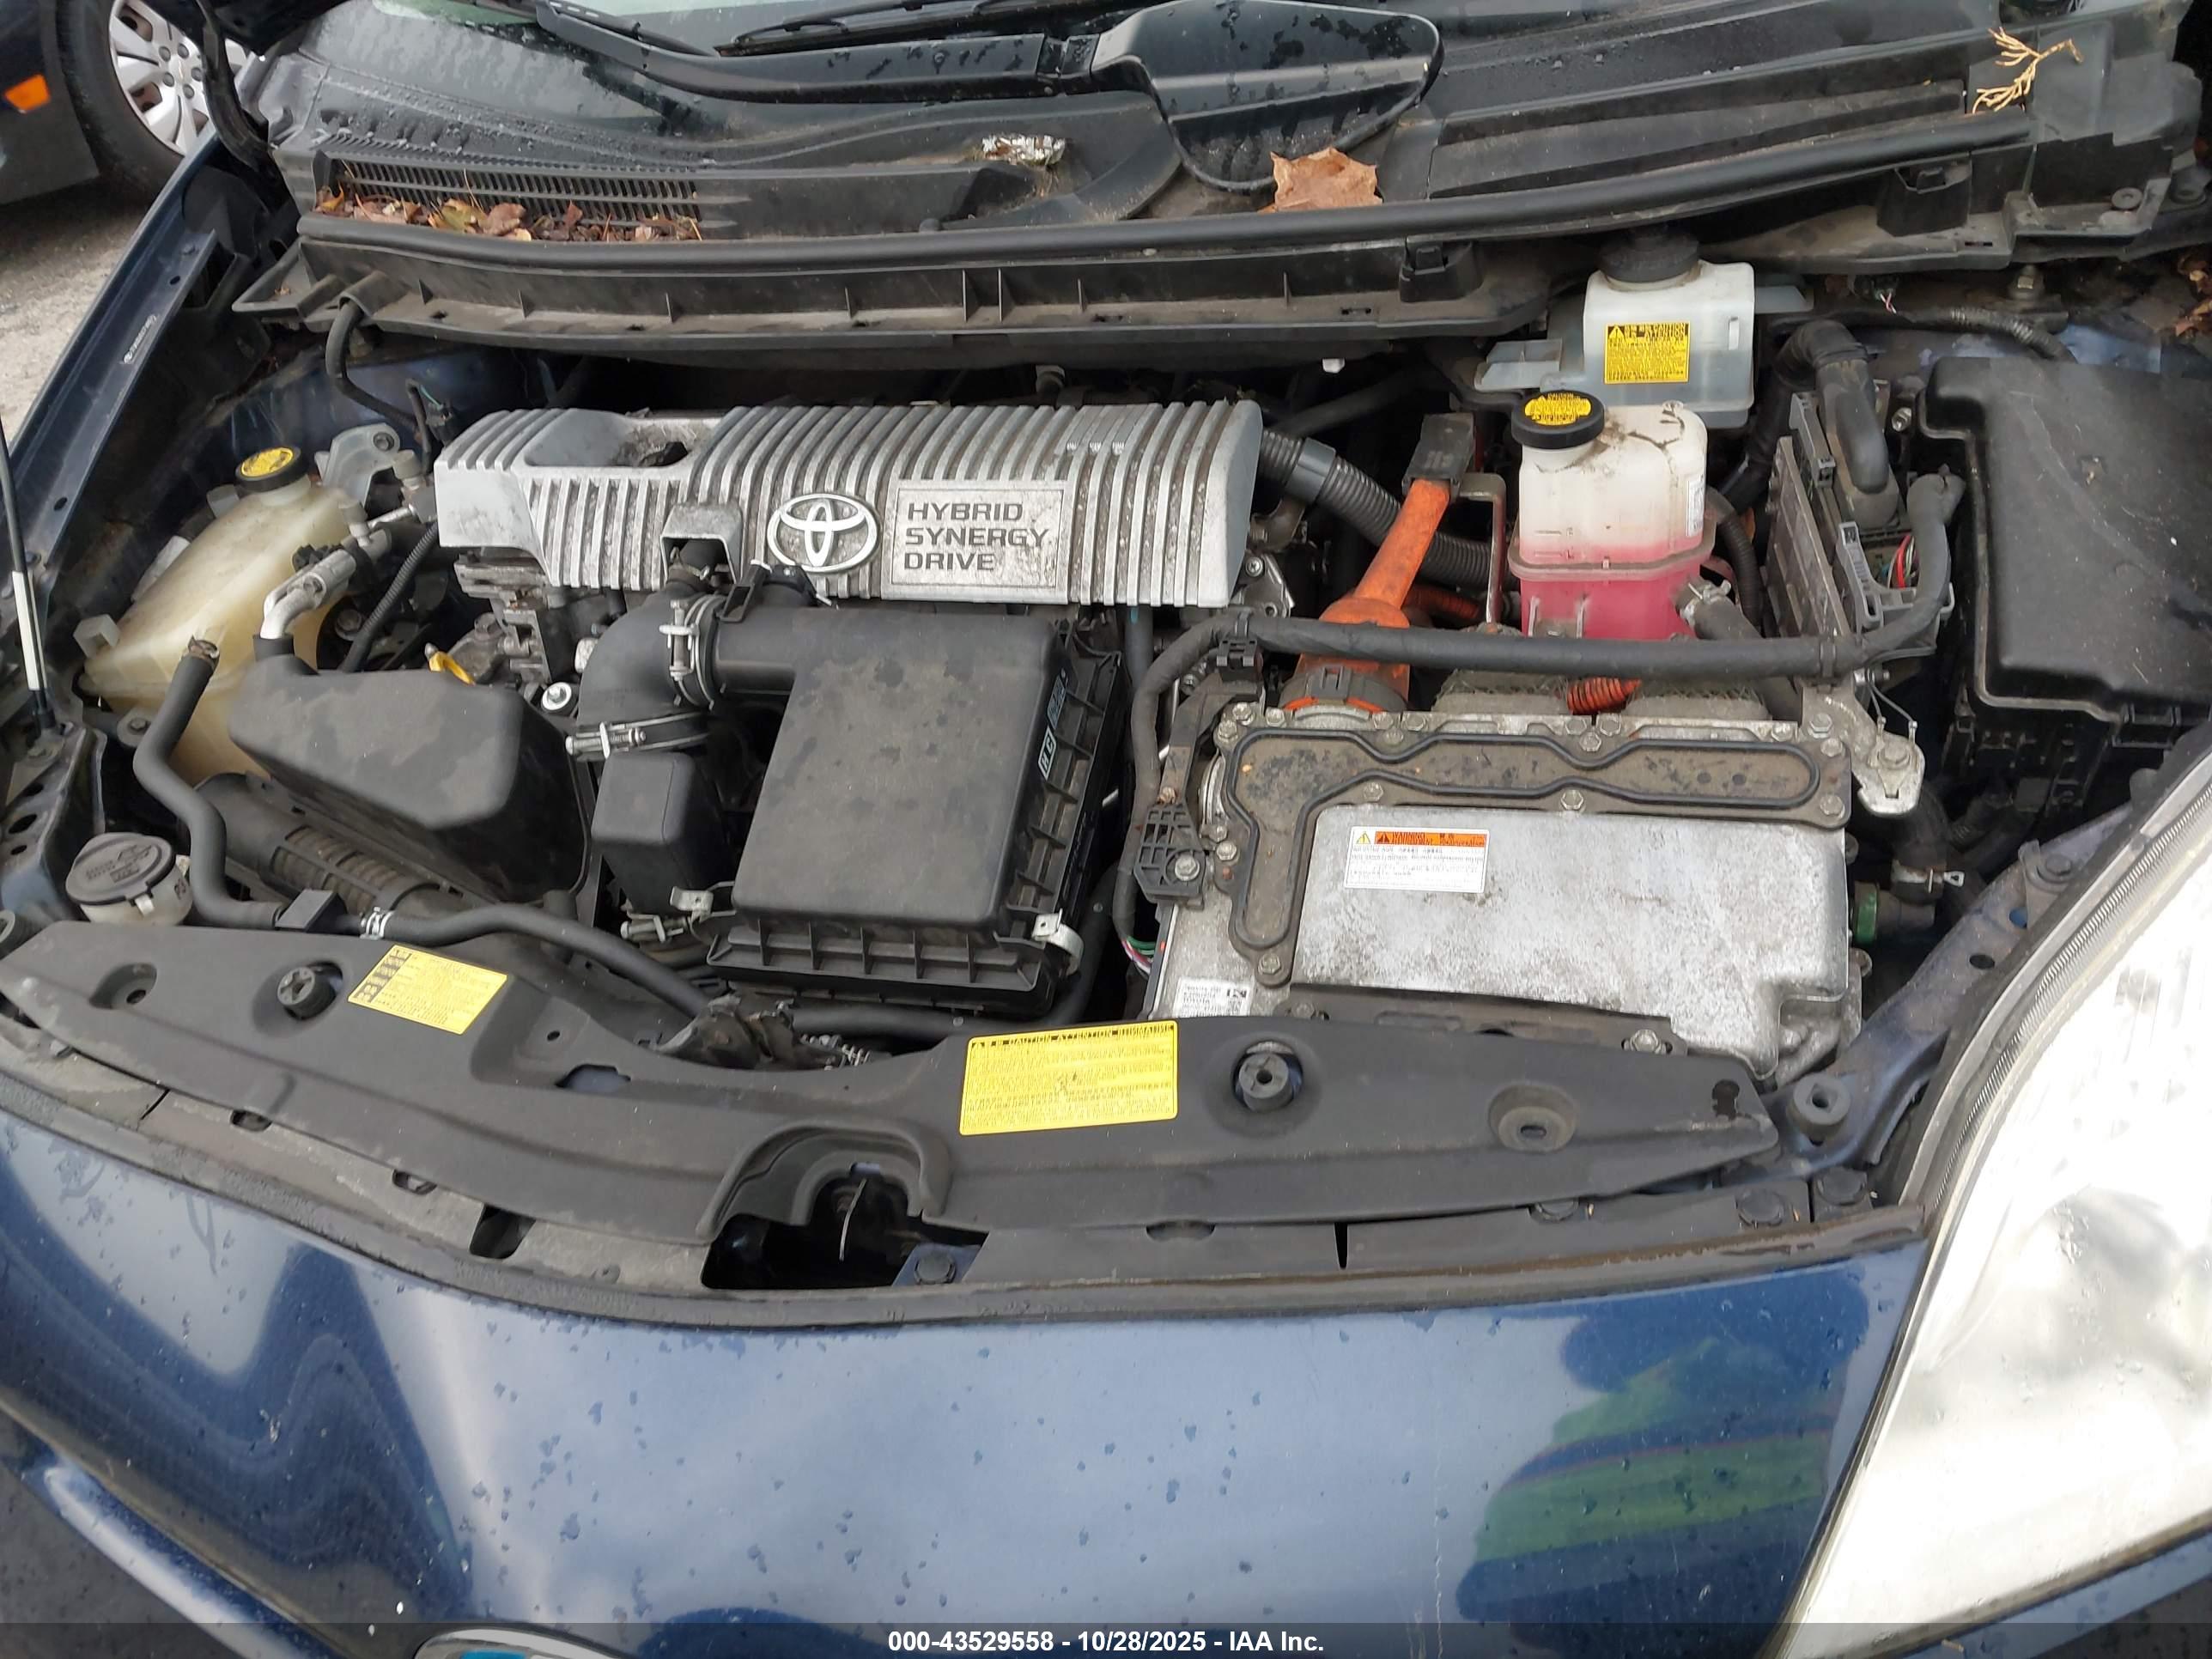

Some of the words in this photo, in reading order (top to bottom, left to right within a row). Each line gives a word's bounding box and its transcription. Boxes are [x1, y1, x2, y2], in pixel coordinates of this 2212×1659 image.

[908, 501, 1024, 521] HYBRID
[905, 526, 1049, 548] SYNERGY
[904, 552, 996, 572] DRIVE
